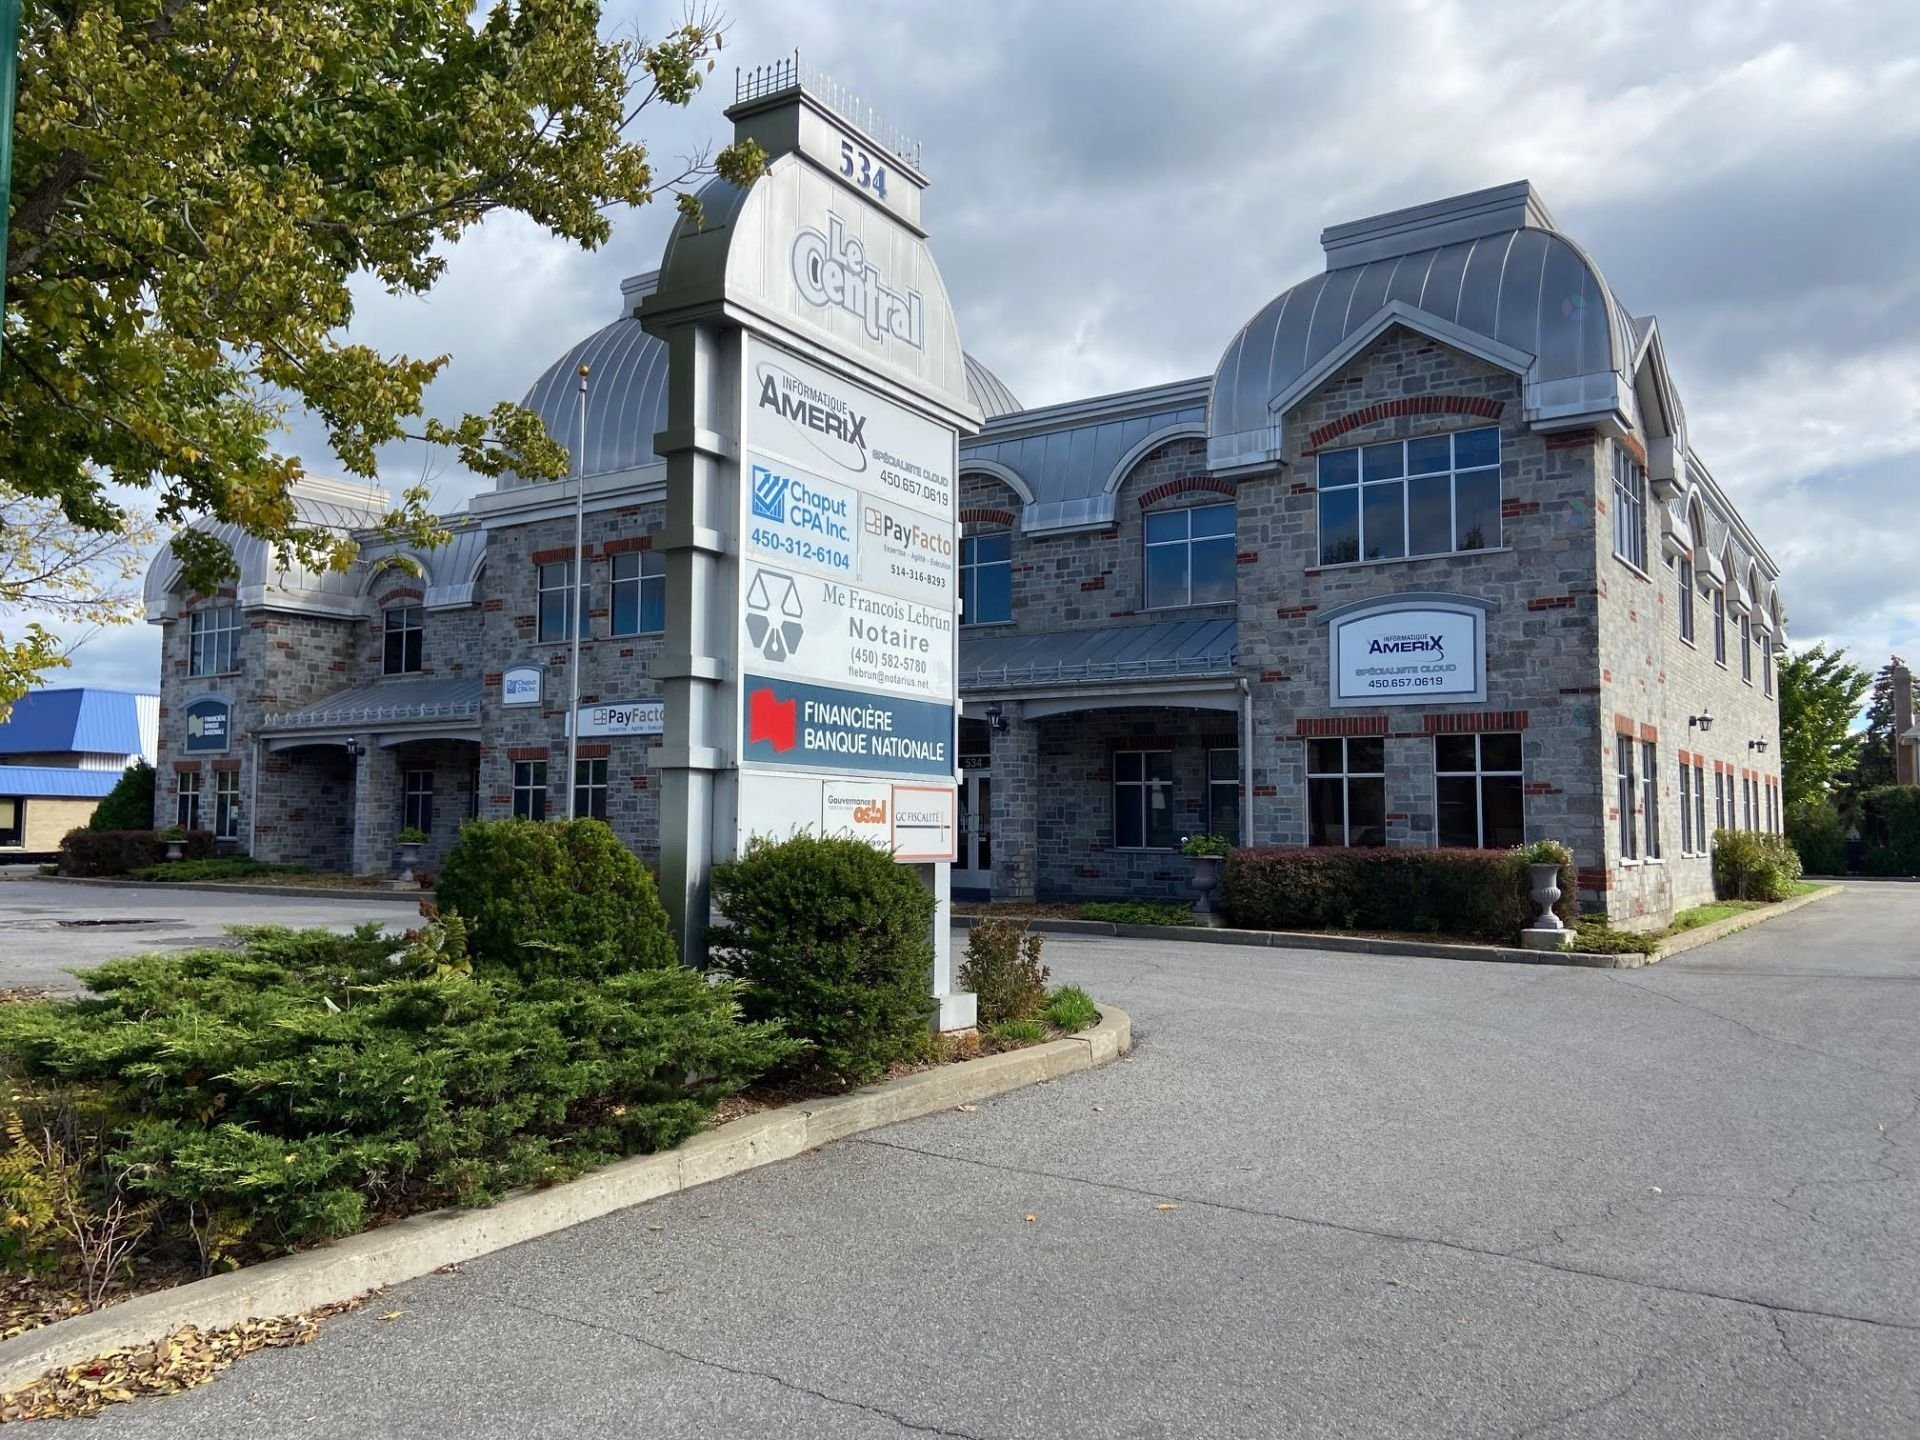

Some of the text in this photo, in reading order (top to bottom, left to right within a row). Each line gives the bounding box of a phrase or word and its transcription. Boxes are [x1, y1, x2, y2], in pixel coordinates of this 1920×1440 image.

[840, 139, 888, 200] 534
[828, 215, 864, 272] Le
[791, 231, 923, 350] Central
[759, 373, 867, 450] AMERIX
[782, 375, 848, 416] INFORMATIQUE
[880, 470, 949, 506] 450.657.0619
[923, 469, 949, 487] CLOUD
[790, 480, 847, 517] Chaput
[790, 505, 850, 542] CPA Inc.
[884, 514, 952, 556] PayFacto
[751, 528, 850, 570] 450-312-6104
[890, 564, 946, 588] 514-316-8293
[823, 582, 846, 606] Me
[907, 604, 951, 632] Lebrun
[849, 617, 930, 653] Notaire
[1368, 635, 1444, 654] AMERIX
[851, 646, 927, 674] (450) 582-5780
[1368, 677, 1443, 688] 450.657.0619
[804, 701, 893, 731] FINANCIÈRE
[804, 728, 945, 761] BANQUE NATIONALE
[828, 795, 871, 806] Gouvernance
[907, 810, 940, 823] FISCALITÉ
